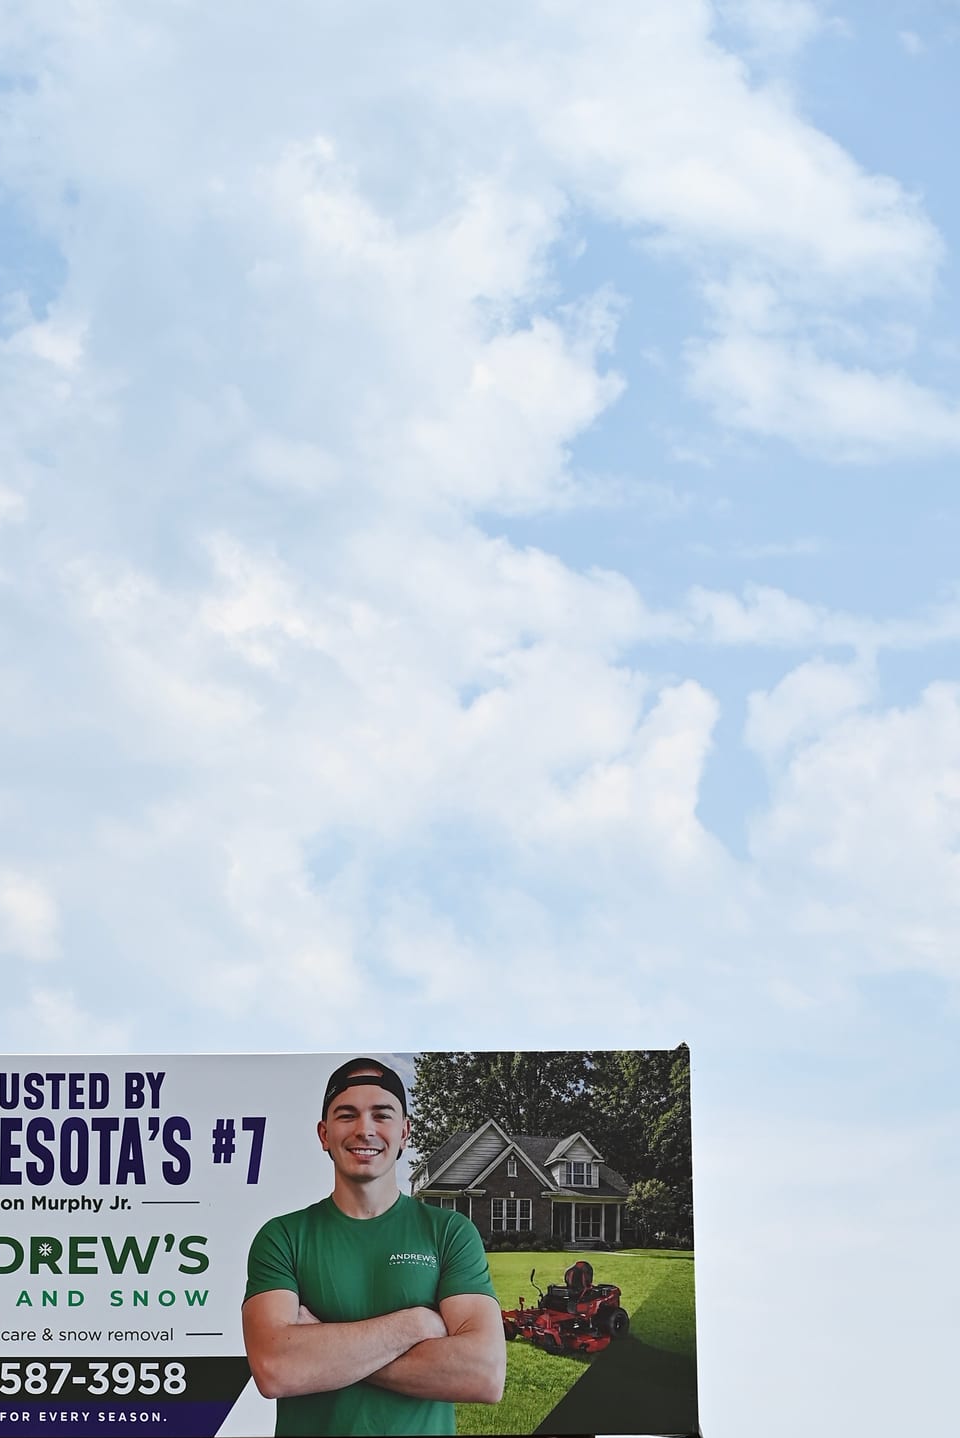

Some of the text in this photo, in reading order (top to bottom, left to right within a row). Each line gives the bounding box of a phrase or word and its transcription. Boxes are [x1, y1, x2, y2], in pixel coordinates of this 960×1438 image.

[124, 1072, 166, 1109] BY
[212, 1116, 267, 1185] #7
[31, 1195, 103, 1213] Murphy
[109, 1195, 132, 1211] Jr.
[16, 1289, 86, 1307] AND
[110, 1289, 210, 1307] SNOW
[1, 1331, 37, 1342] care
[42, 1328, 54, 1342] &
[58, 1331, 102, 1342] snow
[107, 1328, 174, 1342] removal
[0, 1411, 31, 1423] FOR
[38, 1411, 91, 1423] EVERY
[98, 1411, 168, 1423] SEASON.
